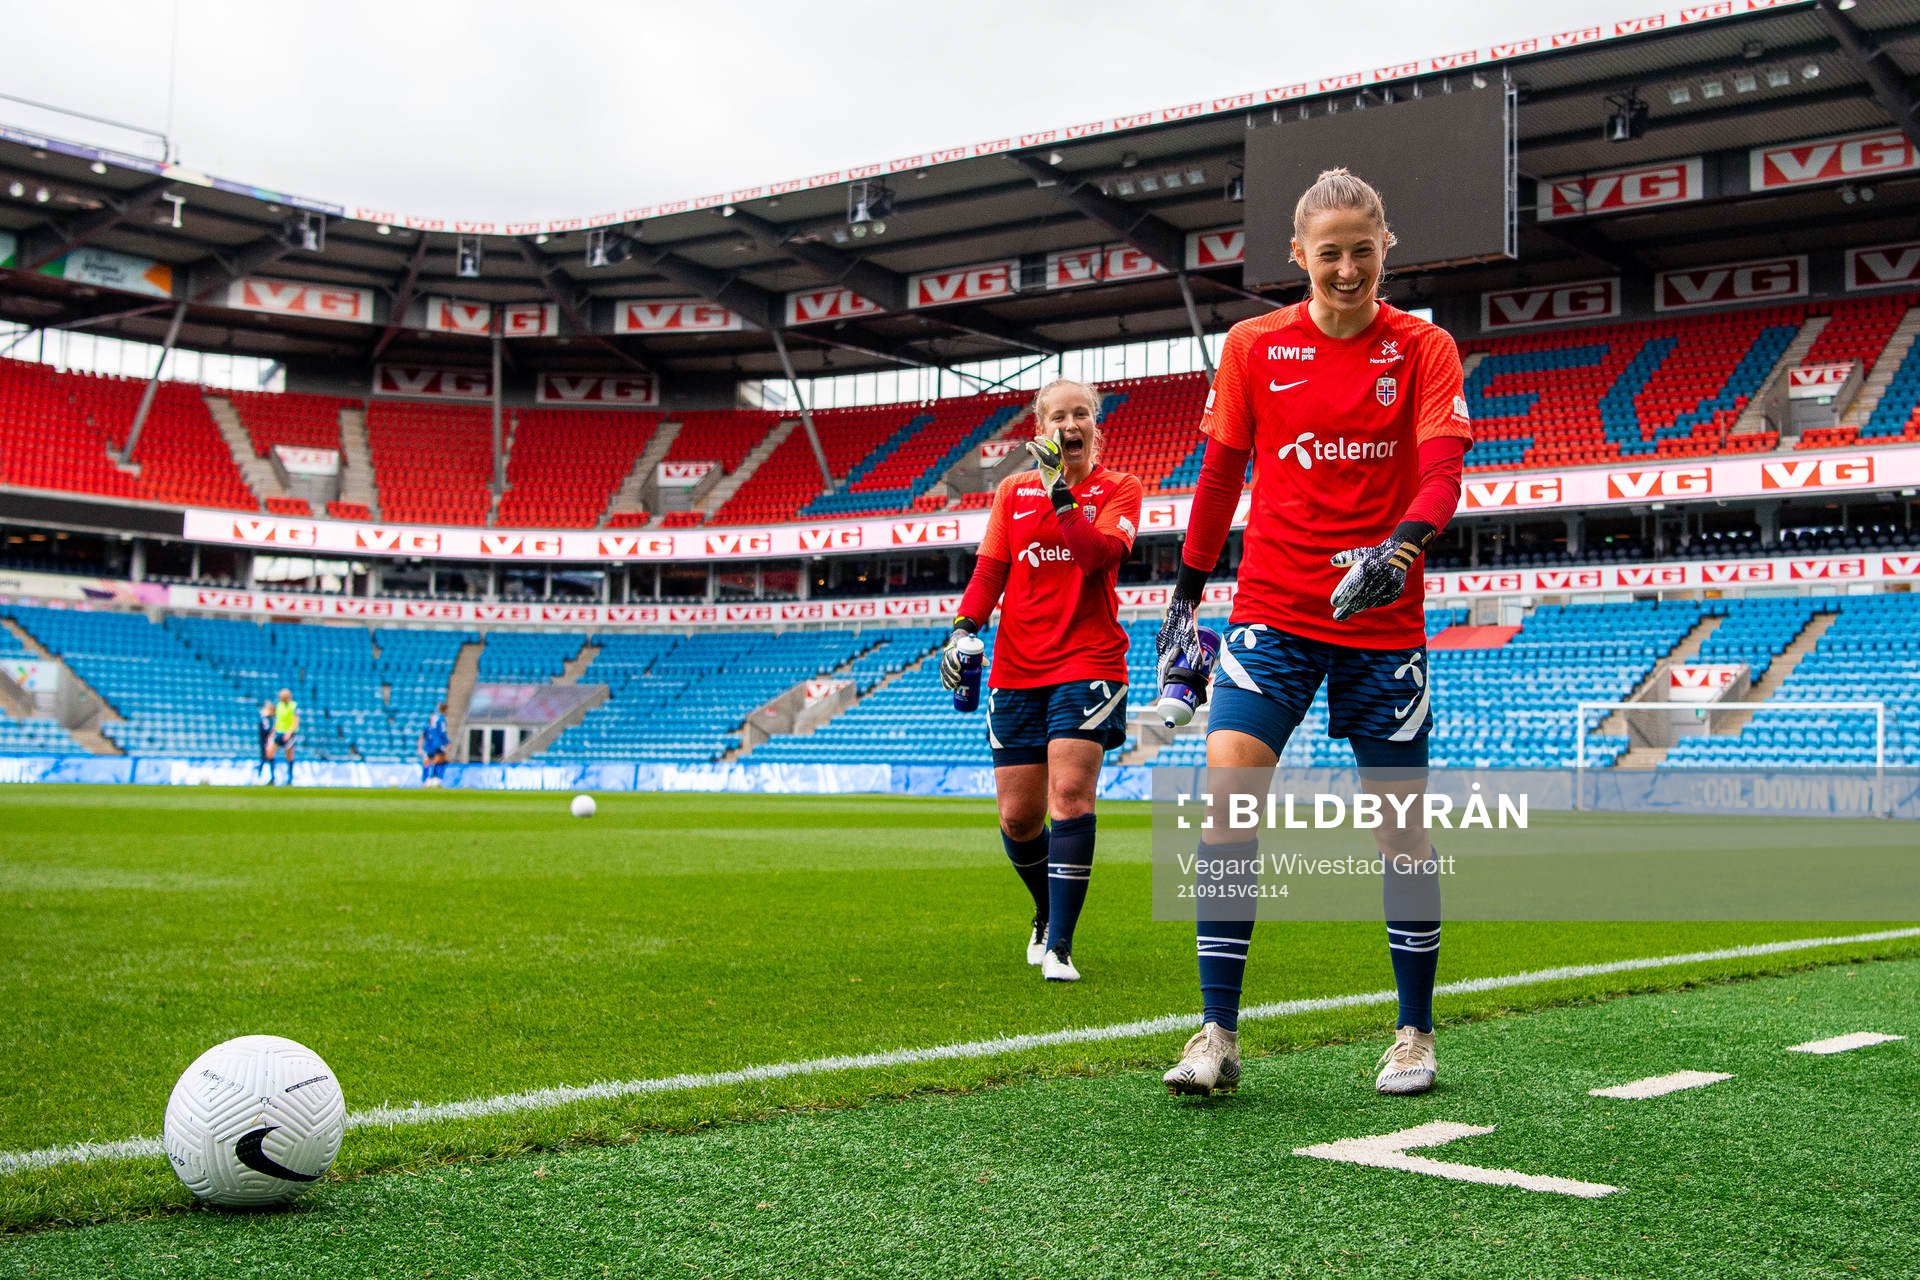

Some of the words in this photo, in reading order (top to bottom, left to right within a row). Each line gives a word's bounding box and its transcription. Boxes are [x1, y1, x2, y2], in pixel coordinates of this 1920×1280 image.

[731, 189, 760, 202] VG
[769, 180, 800, 194] VG
[808, 173, 839, 187] VG
[847, 165, 880, 180] VG
[889, 156, 922, 172] VG
[930, 147, 966, 164] VG
[974, 140, 1010, 155] VG
[1020, 131, 1055, 146] VG
[1067, 123, 1102, 137] VG
[1114, 114, 1151, 129] VG
[1163, 104, 1202, 120] VG
[1213, 94, 1252, 111] VG
[1265, 85, 1306, 101] VG
[1319, 73, 1361, 91] VG
[1374, 62, 1418, 80] VG
[1432, 51, 1477, 69] VG
[1491, 39, 1537, 59] VG
[1552, 27, 1600, 47] VG
[1616, 14, 1665, 35] VG
[1681, 2, 1732, 23] VG
[1765, 136, 1905, 186] VG
[1556, 168, 1683, 213] VG
[1060, 249, 1153, 282] VG
[1200, 233, 1244, 266] V
[921, 264, 1010, 303] VG
[1668, 263, 1797, 303] VG
[1858, 247, 1920, 290] V
[246, 282, 358, 317] VG
[1493, 285, 1607, 322] VG
[449, 304, 539, 334] VG
[629, 304, 730, 330] VG
[1268, 346, 1300, 360] KIWI
[385, 368, 491, 397] VG
[549, 374, 650, 402] VG
[1791, 368, 1853, 386] VG
[1313, 437, 1398, 461] telenor
[234, 521, 317, 547] VG
[355, 530, 441, 554] VG
[480, 535, 563, 557] VG
[598, 536, 675, 557] VG
[705, 532, 771, 555] VG
[799, 525, 862, 551] VG
[892, 519, 960, 545] VG
[1142, 503, 1176, 529] G
[1468, 478, 1561, 508] VG
[1608, 467, 1711, 499] VG
[1762, 457, 1874, 489] VG
[1040, 546, 1074, 561] tele
[197, 590, 254, 609] VG
[264, 595, 324, 613] VG
[335, 599, 393, 616] VG
[404, 602, 462, 619] VG
[474, 605, 530, 621] VG
[541, 606, 598, 622] VG
[607, 607, 659, 622] VG
[668, 607, 717, 623] VG
[725, 606, 772, 621] VG
[781, 603, 823, 620] VG
[831, 601, 876, 618] VG
[883, 599, 930, 616] VG
[939, 598, 959, 613] V
[1117, 588, 1168, 606] VG
[1203, 586, 1233, 607] G
[1458, 573, 1522, 593] VG
[1535, 569, 1603, 590] VG
[1616, 565, 1687, 587] VG
[1701, 561, 1774, 584] VG
[1789, 558, 1866, 580] VG
[1882, 555, 1920, 576] V
[1754, 778, 1829, 810] DOWN
